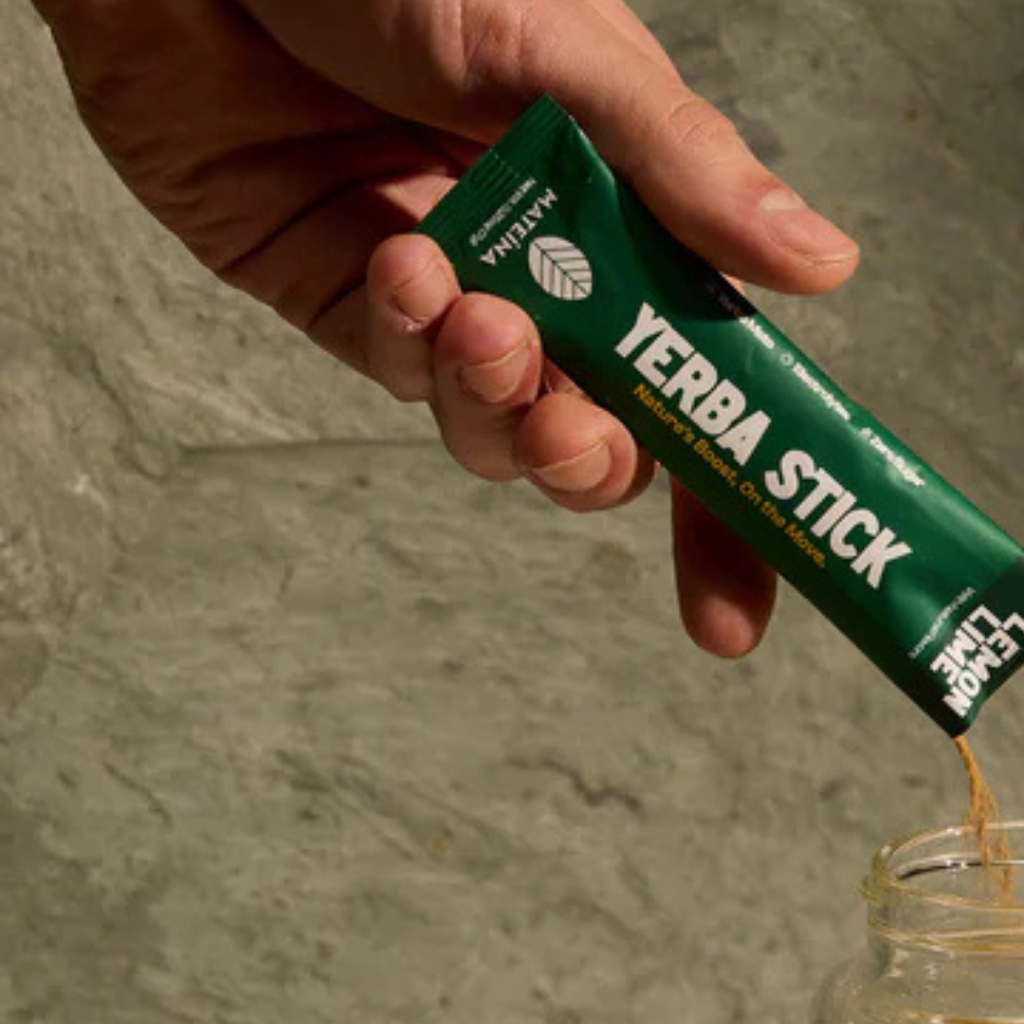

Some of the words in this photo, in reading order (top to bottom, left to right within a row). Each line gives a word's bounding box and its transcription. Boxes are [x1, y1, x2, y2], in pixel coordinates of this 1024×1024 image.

[480, 188, 558, 266] MATEÍNA
[614, 302, 771, 467] YERBA
[764, 449, 912, 589] STICK
[632, 381, 695, 444] Nature's
[692, 437, 739, 488] Boost,
[738, 480, 763, 507] On
[760, 499, 786, 530] the
[783, 521, 827, 568] Move.
[930, 604, 1001, 686] LIME
